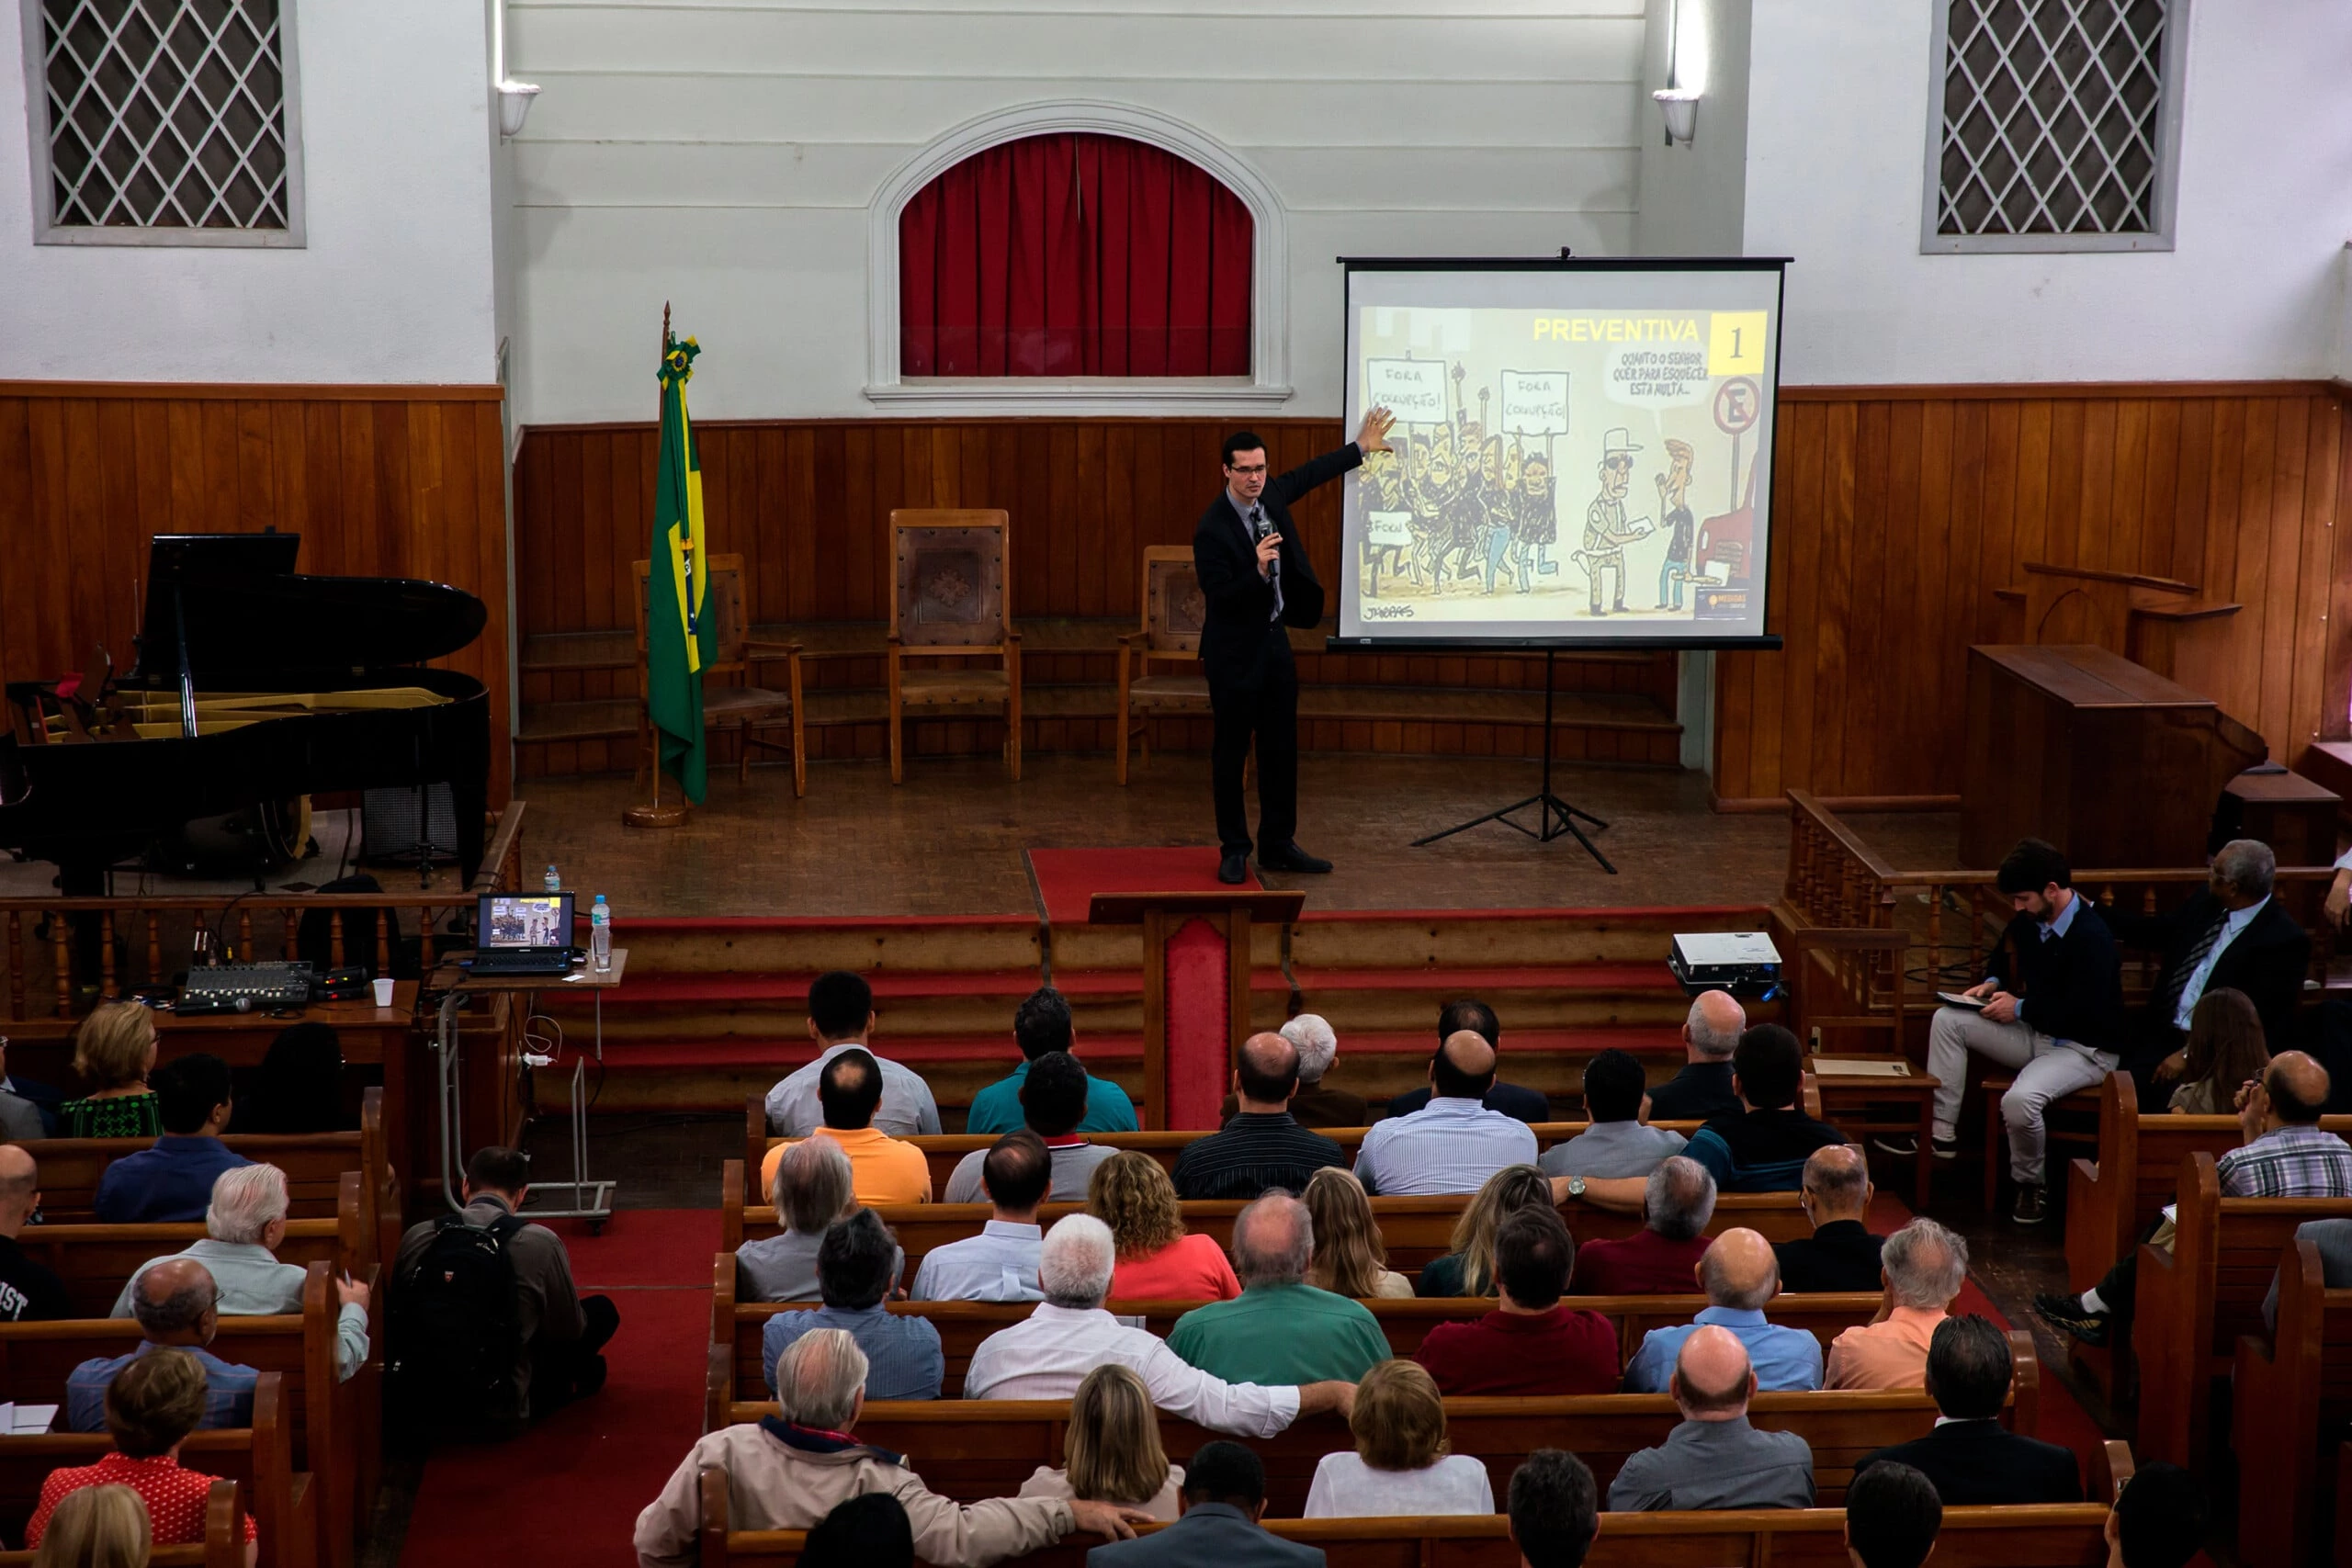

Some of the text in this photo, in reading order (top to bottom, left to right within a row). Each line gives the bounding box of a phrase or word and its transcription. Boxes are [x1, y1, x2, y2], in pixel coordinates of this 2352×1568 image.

[1533, 318, 1700, 342] PREVENTIVA
[1730, 327, 1744, 358] 1
[1622, 352, 1702, 366] QUANTO O SENHOR
[1385, 368, 1423, 383] FORA
[1638, 367, 1661, 380] PARA
[1662, 367, 1709, 381] ESQUECER
[1630, 382, 1653, 395] ESTA
